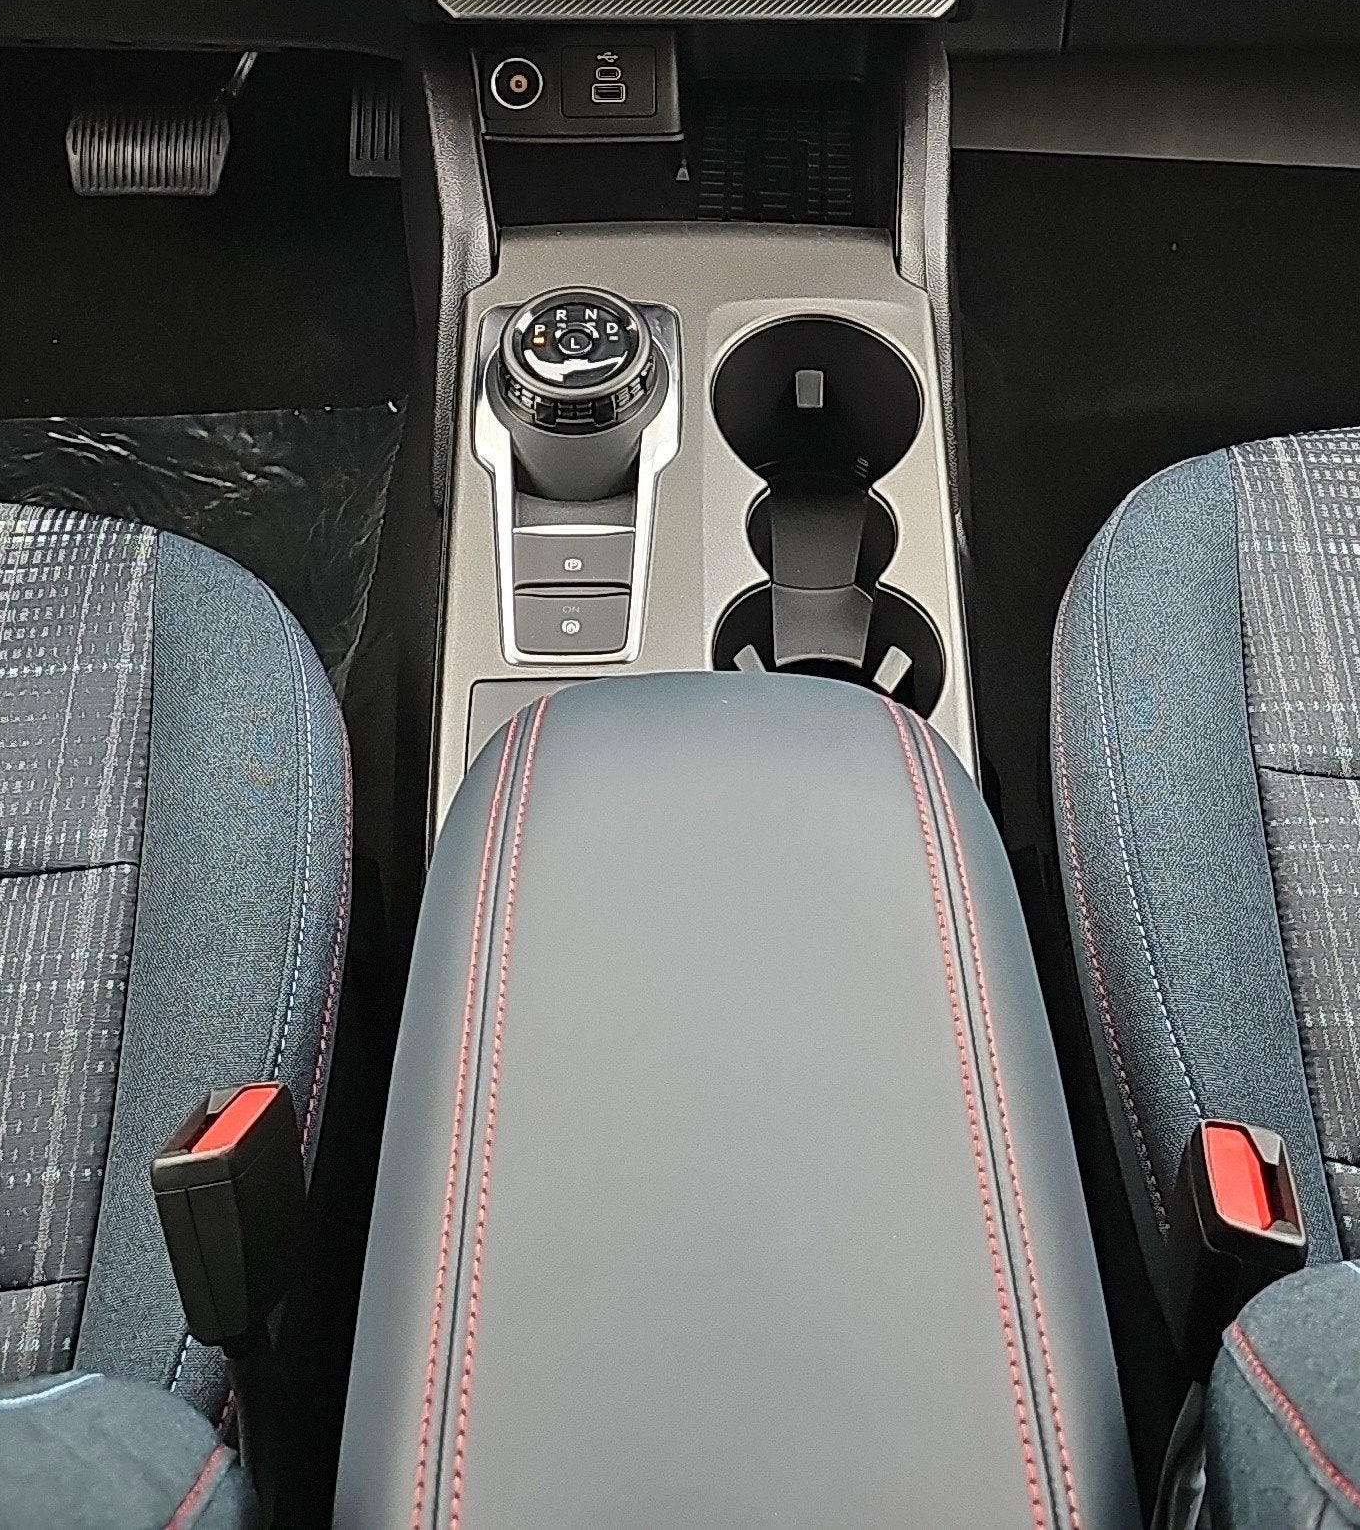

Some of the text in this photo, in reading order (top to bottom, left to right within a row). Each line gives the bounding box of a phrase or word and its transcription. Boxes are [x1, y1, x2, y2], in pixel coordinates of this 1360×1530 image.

[555, 309, 567, 321] R
[585, 308, 597, 320] N
[534, 324, 545, 336] P
[606, 323, 618, 334] D
[570, 338, 580, 349] L
[562, 605, 580, 613] ON
